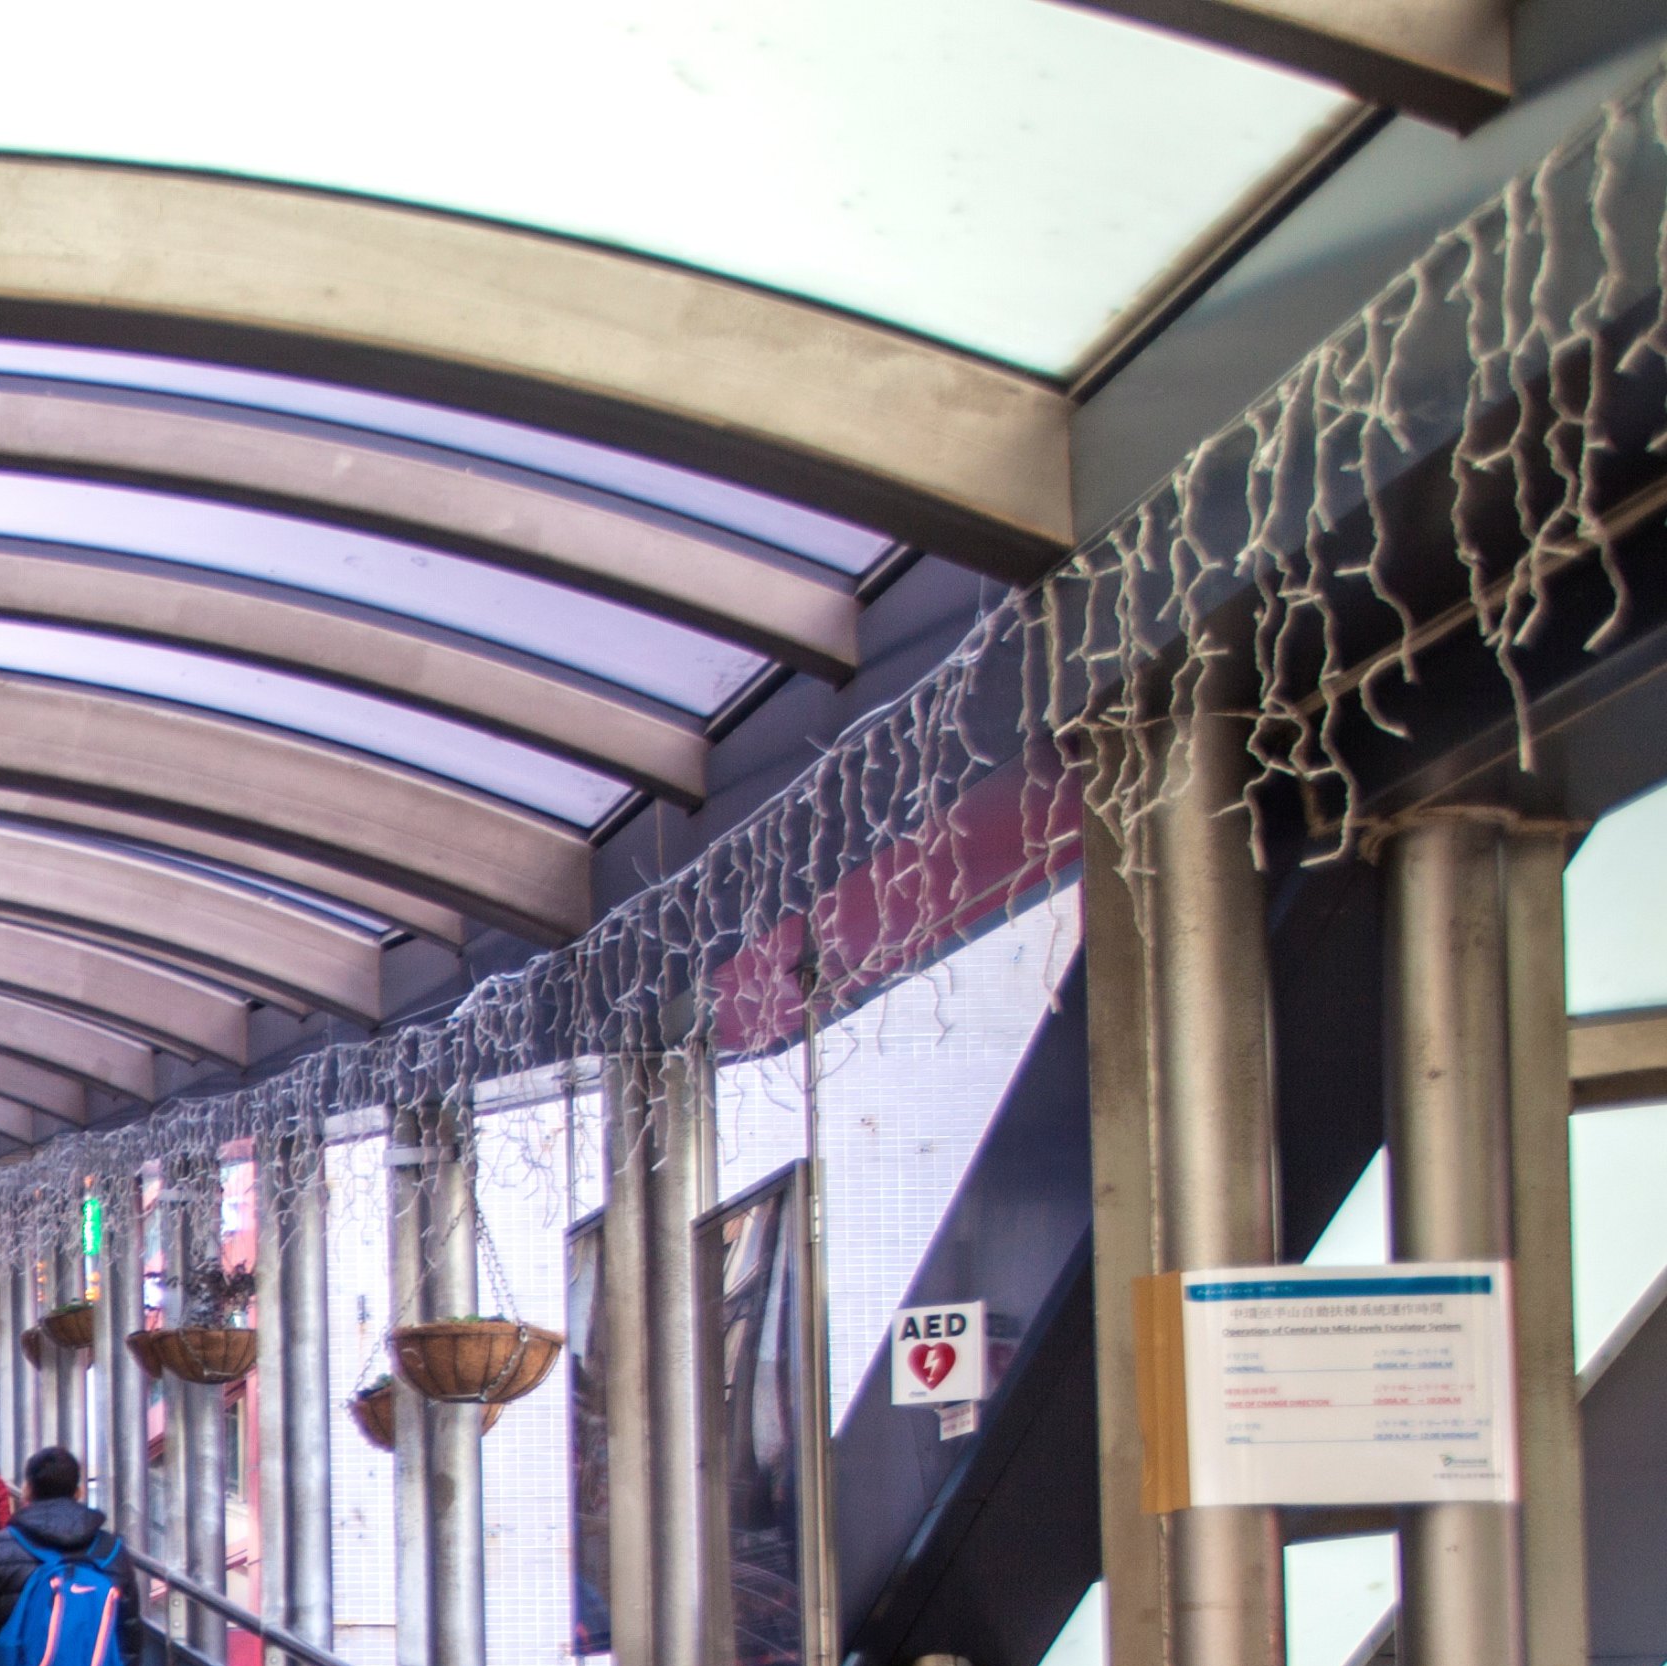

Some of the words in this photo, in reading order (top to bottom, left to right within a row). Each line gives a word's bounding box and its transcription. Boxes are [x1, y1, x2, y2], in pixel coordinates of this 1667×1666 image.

[899, 1312, 967, 1341] AED
[1222, 1327, 1269, 1337] Operation
[1284, 1325, 1317, 1335] Central
[1332, 1323, 1382, 1333] Mid-Levels
[1385, 1323, 1425, 1333] Escalator
[1429, 1322, 1462, 1334] System
